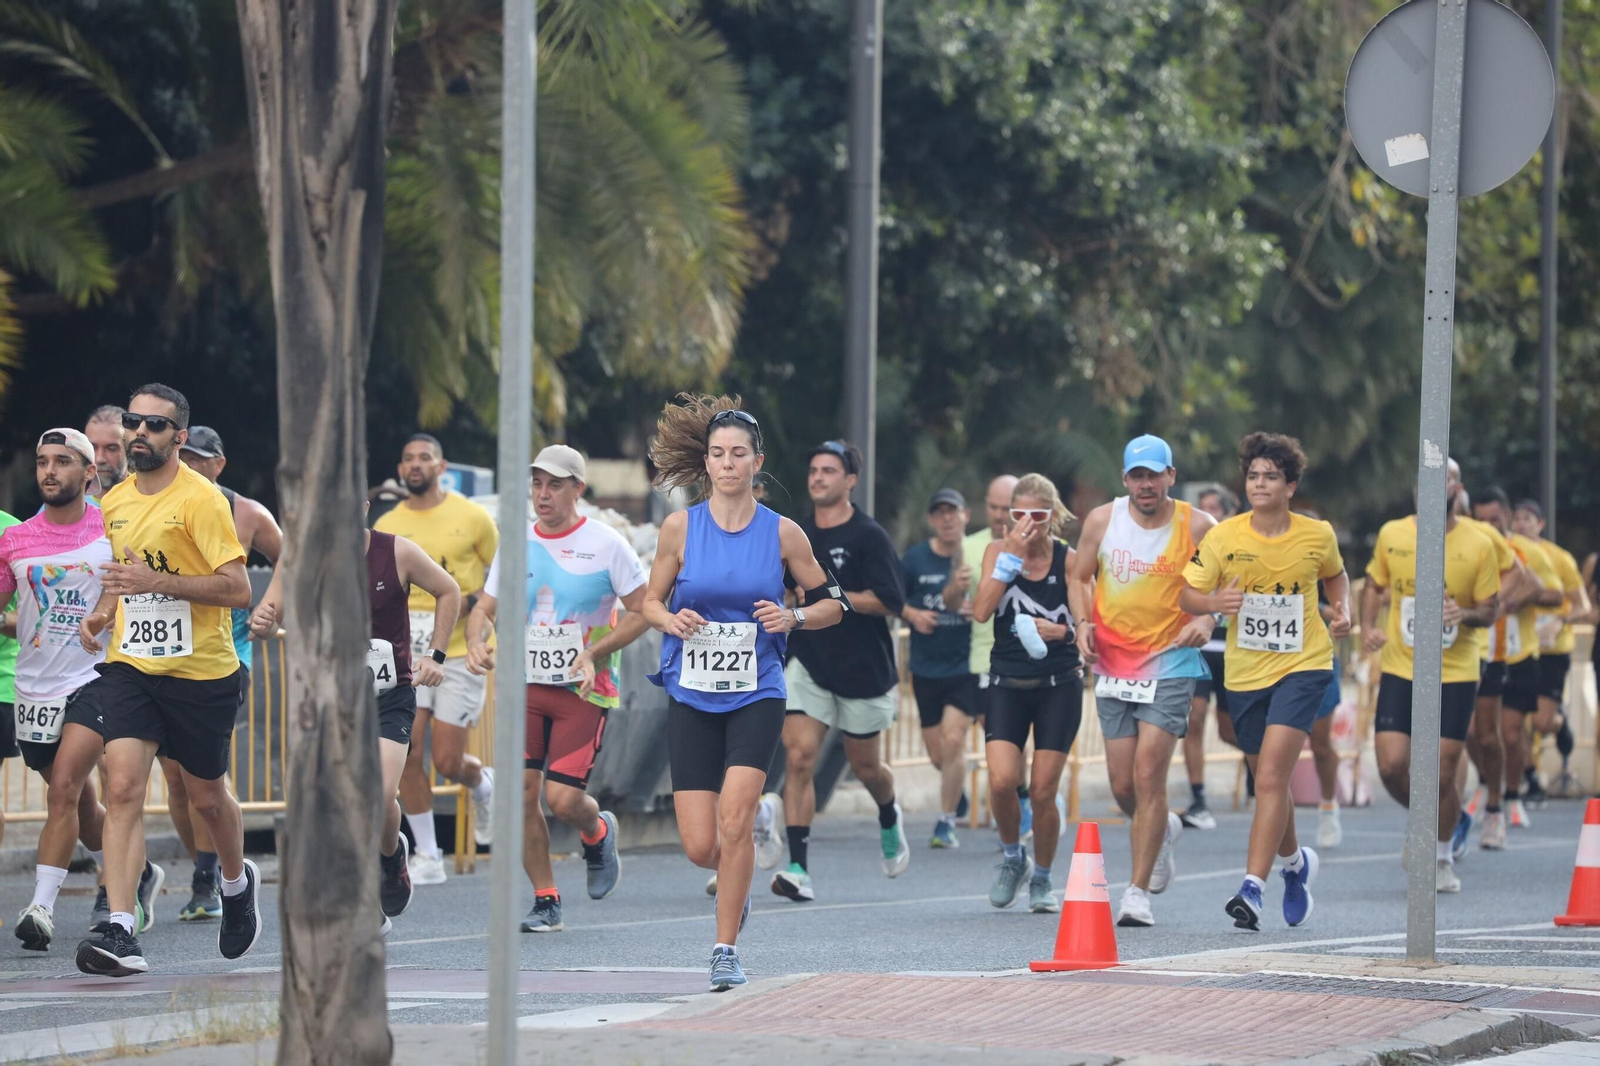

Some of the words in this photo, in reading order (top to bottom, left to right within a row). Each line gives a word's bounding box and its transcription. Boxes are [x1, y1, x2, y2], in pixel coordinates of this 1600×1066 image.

[1110, 549, 1175, 584] Hollywood
[129, 618, 183, 643] 2881
[1245, 617, 1298, 638] 5914
[529, 647, 579, 670] 7832
[687, 649, 754, 671] 11227
[18, 703, 61, 728] 8467
